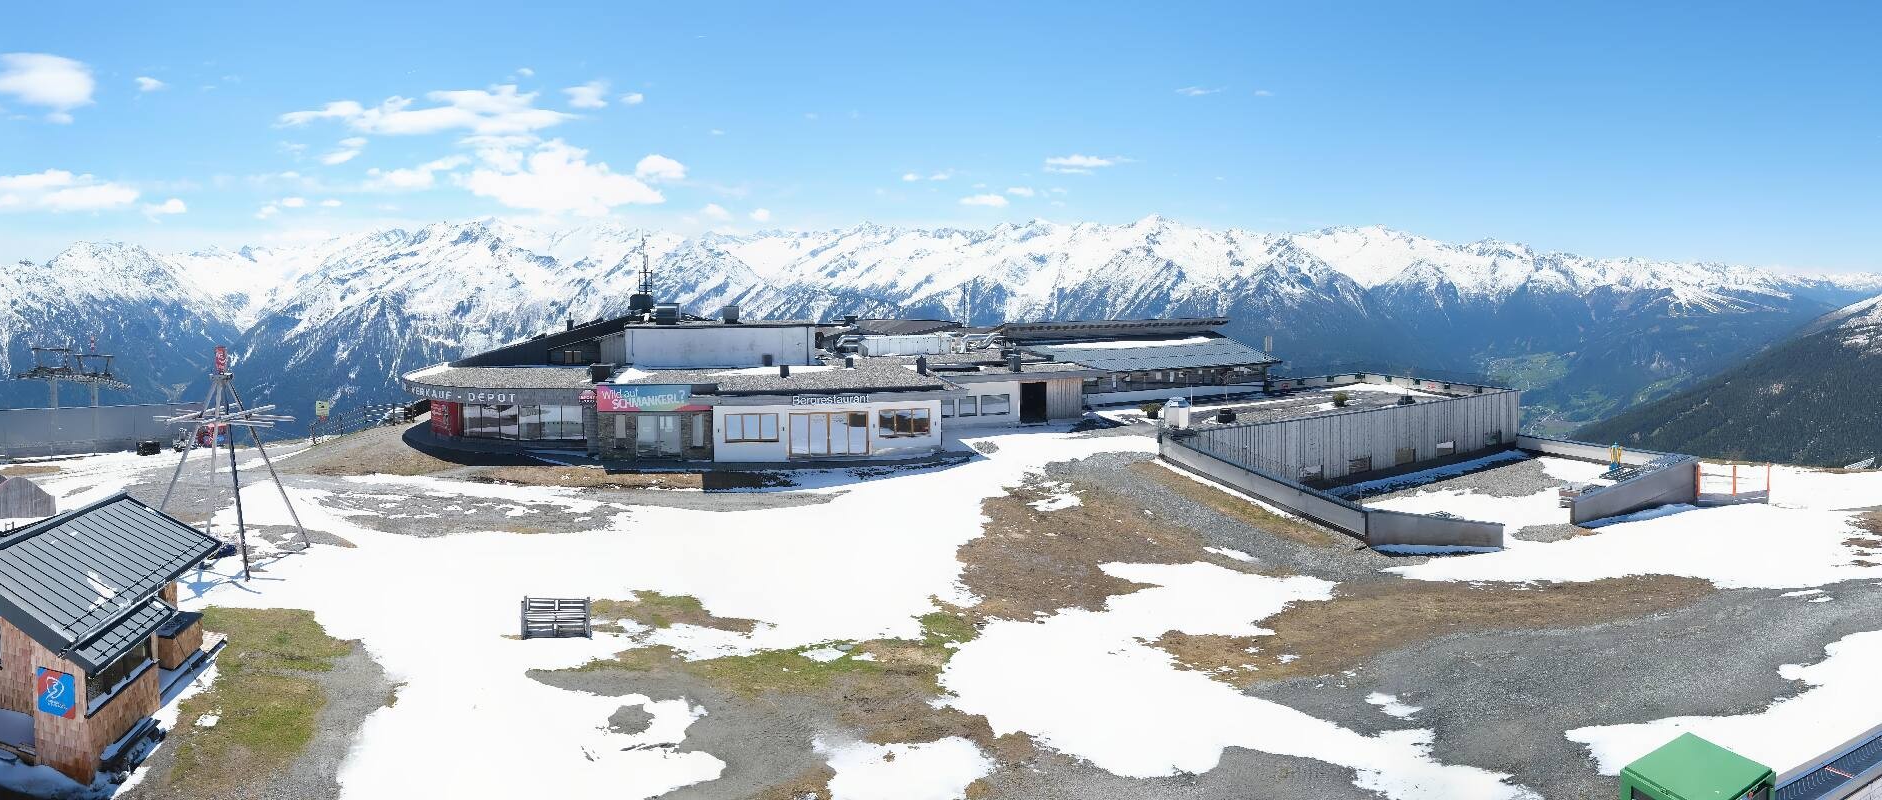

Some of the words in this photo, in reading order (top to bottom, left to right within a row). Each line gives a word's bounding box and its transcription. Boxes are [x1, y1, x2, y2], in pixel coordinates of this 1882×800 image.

[411, 386, 452, 400] VERKAUF
[468, 392, 516, 403] DEPOT
[602, 388, 622, 400] Wild
[624, 388, 639, 397] auf
[612, 390, 686, 410] SCHMANKERL?
[792, 394, 870, 406] Bergrestaurant
